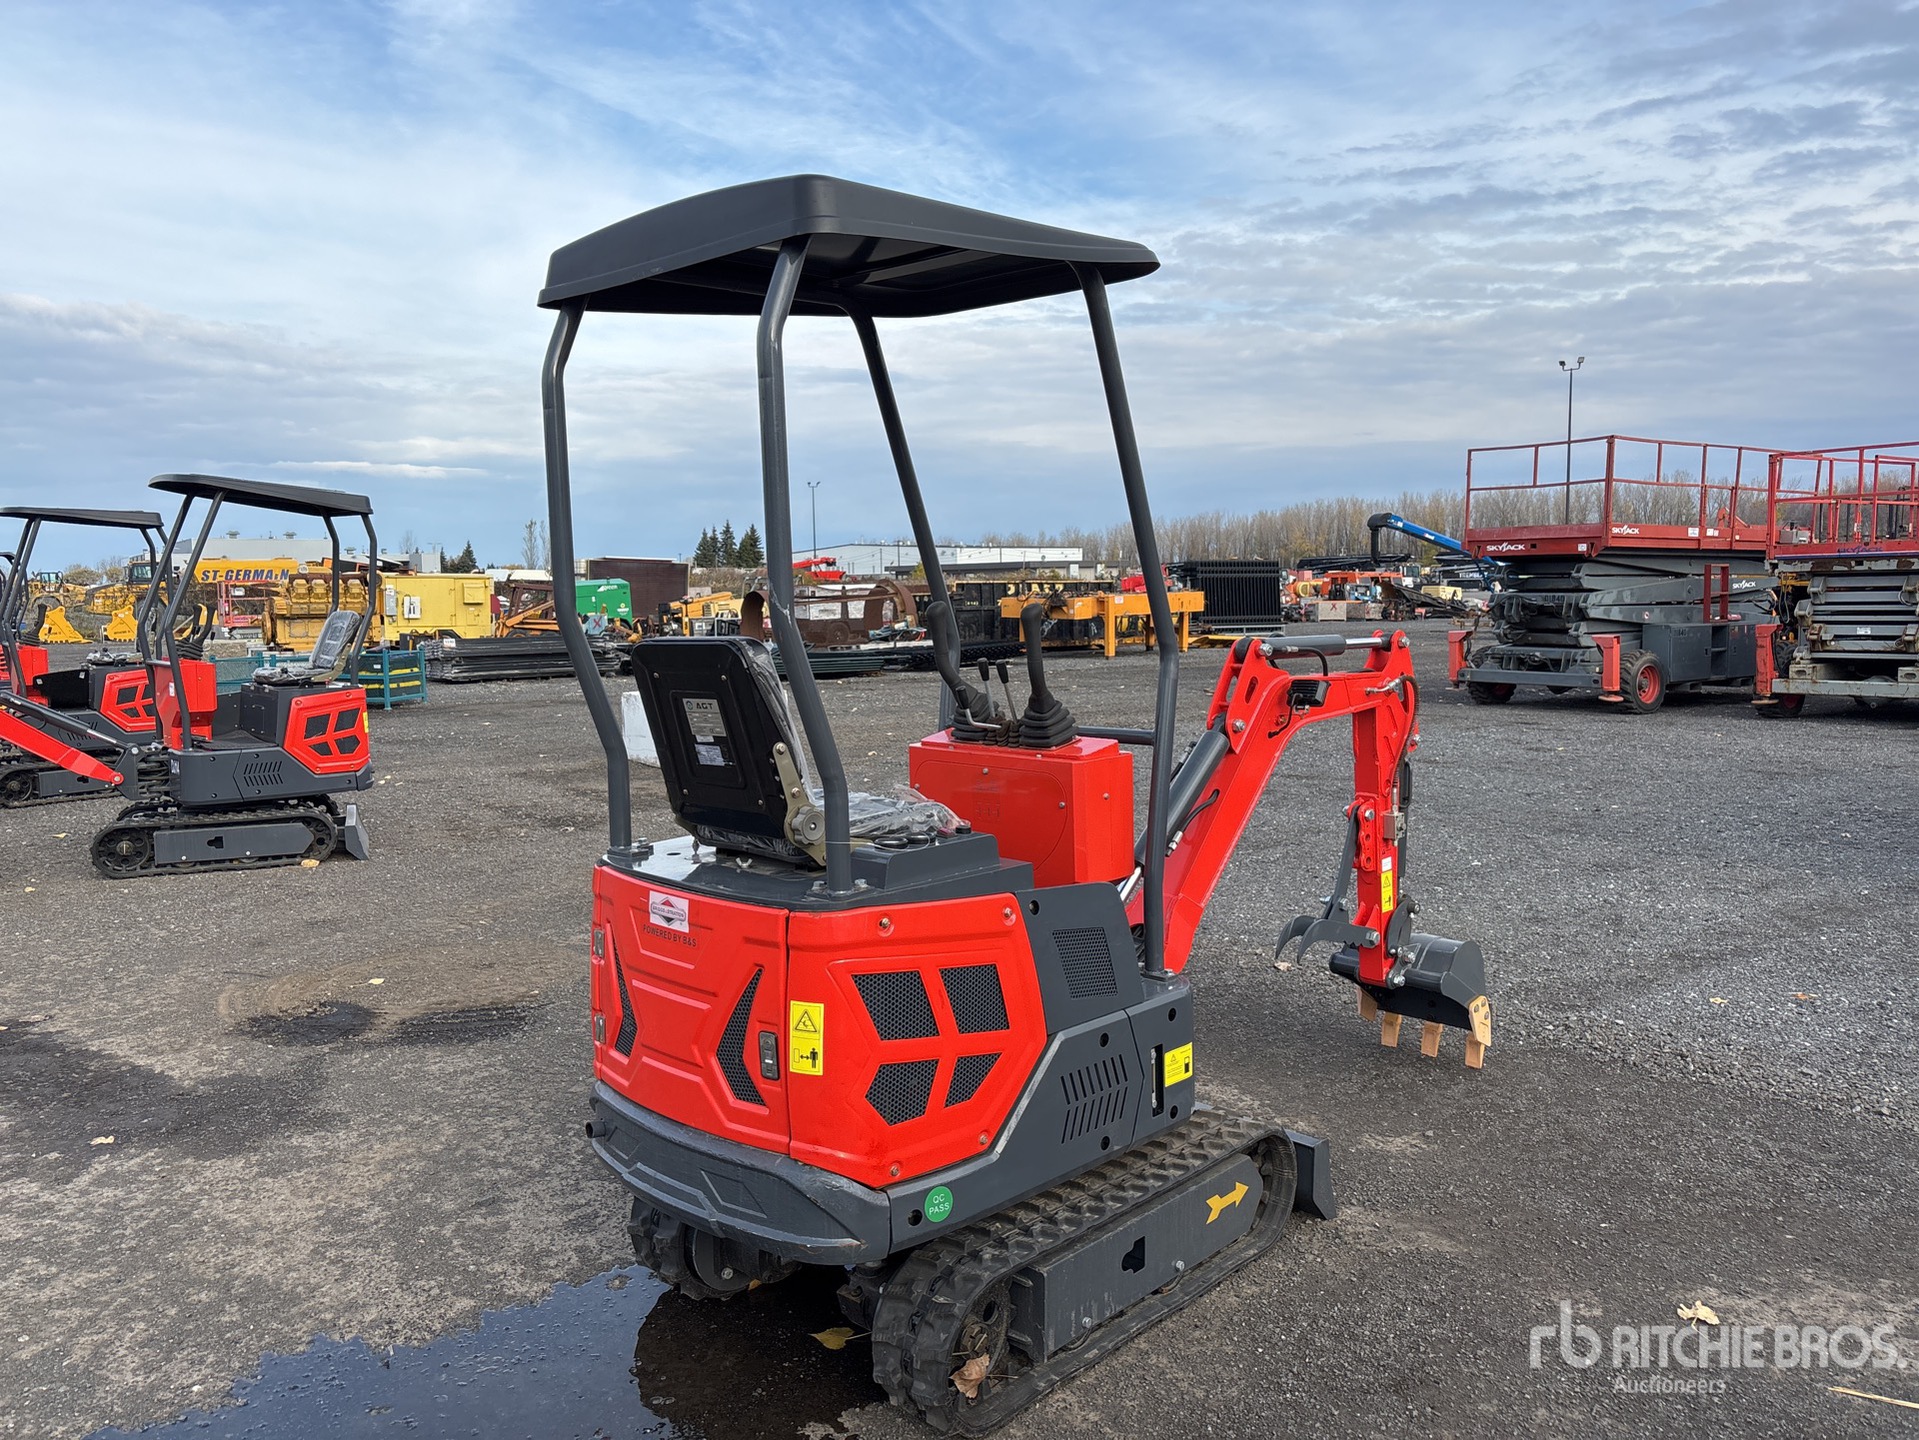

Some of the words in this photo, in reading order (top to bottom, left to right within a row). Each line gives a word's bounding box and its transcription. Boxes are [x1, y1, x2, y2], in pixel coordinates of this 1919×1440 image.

[1612, 525, 1639, 535] SKYJACK
[1486, 542, 1525, 553] SKYJACK
[696, 702, 713, 710] AGT
[643, 925, 672, 940] POWERED
[673, 933, 682, 943] BY
[683, 936, 697, 947] B&S
[933, 1194, 945, 1203] QC
[929, 1202, 950, 1215] PASS
